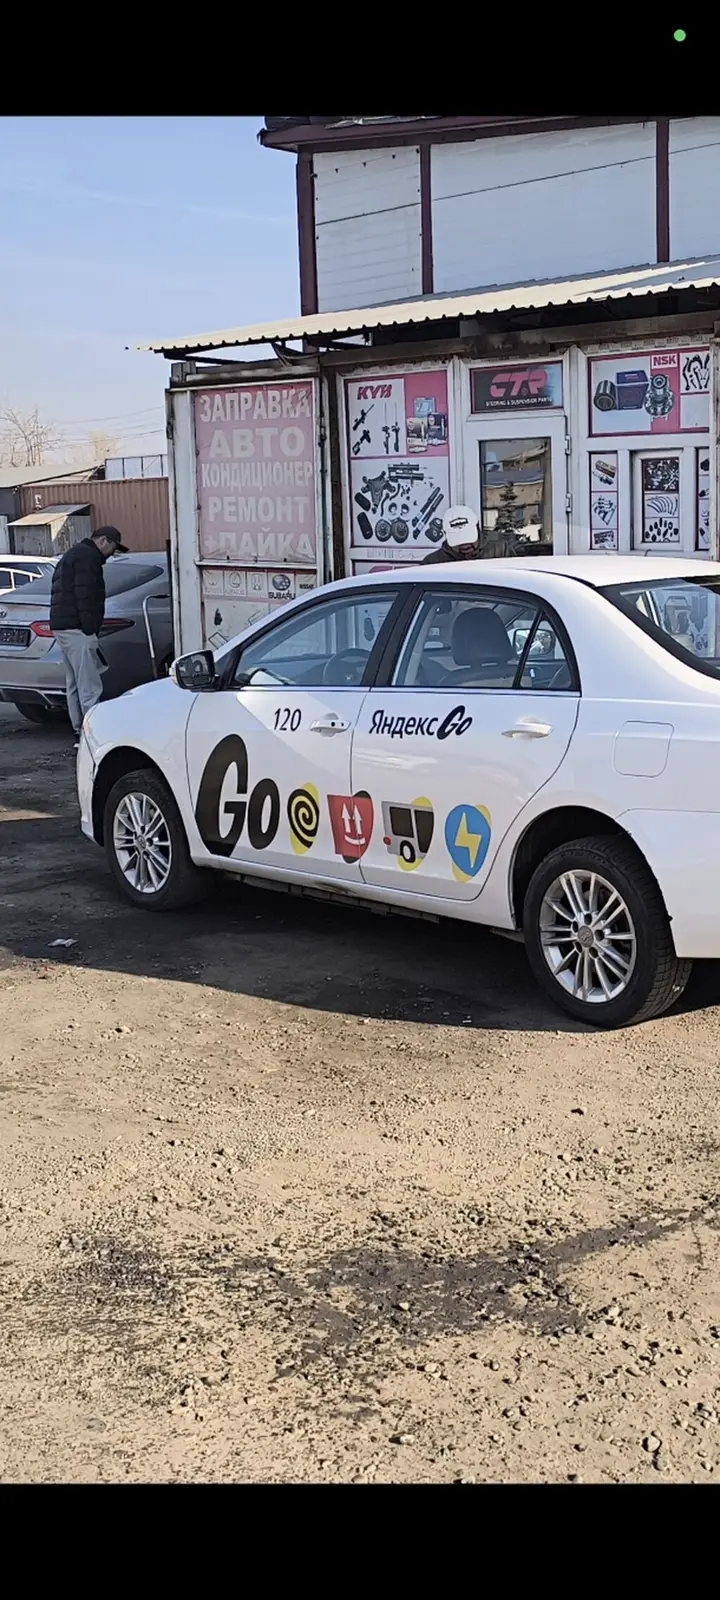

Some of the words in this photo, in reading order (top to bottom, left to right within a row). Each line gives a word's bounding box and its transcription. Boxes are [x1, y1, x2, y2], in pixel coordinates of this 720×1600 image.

[652, 354, 677, 367] NSK
[356, 384, 393, 400] KYB
[490, 369, 548, 397] CTR
[200, 389, 311, 422] ЗАПРАВКА
[209, 426, 306, 459] АВТО
[201, 461, 313, 491] КОНДИЦИОНЕР
[208, 497, 309, 523] РЕМОНТ
[268, 590, 296, 600] SUBARU
[273, 708, 302, 733] 120
[369, 709, 438, 738] Яндекс
[436, 705, 473, 740] Go
[194, 733, 281, 858] Go
